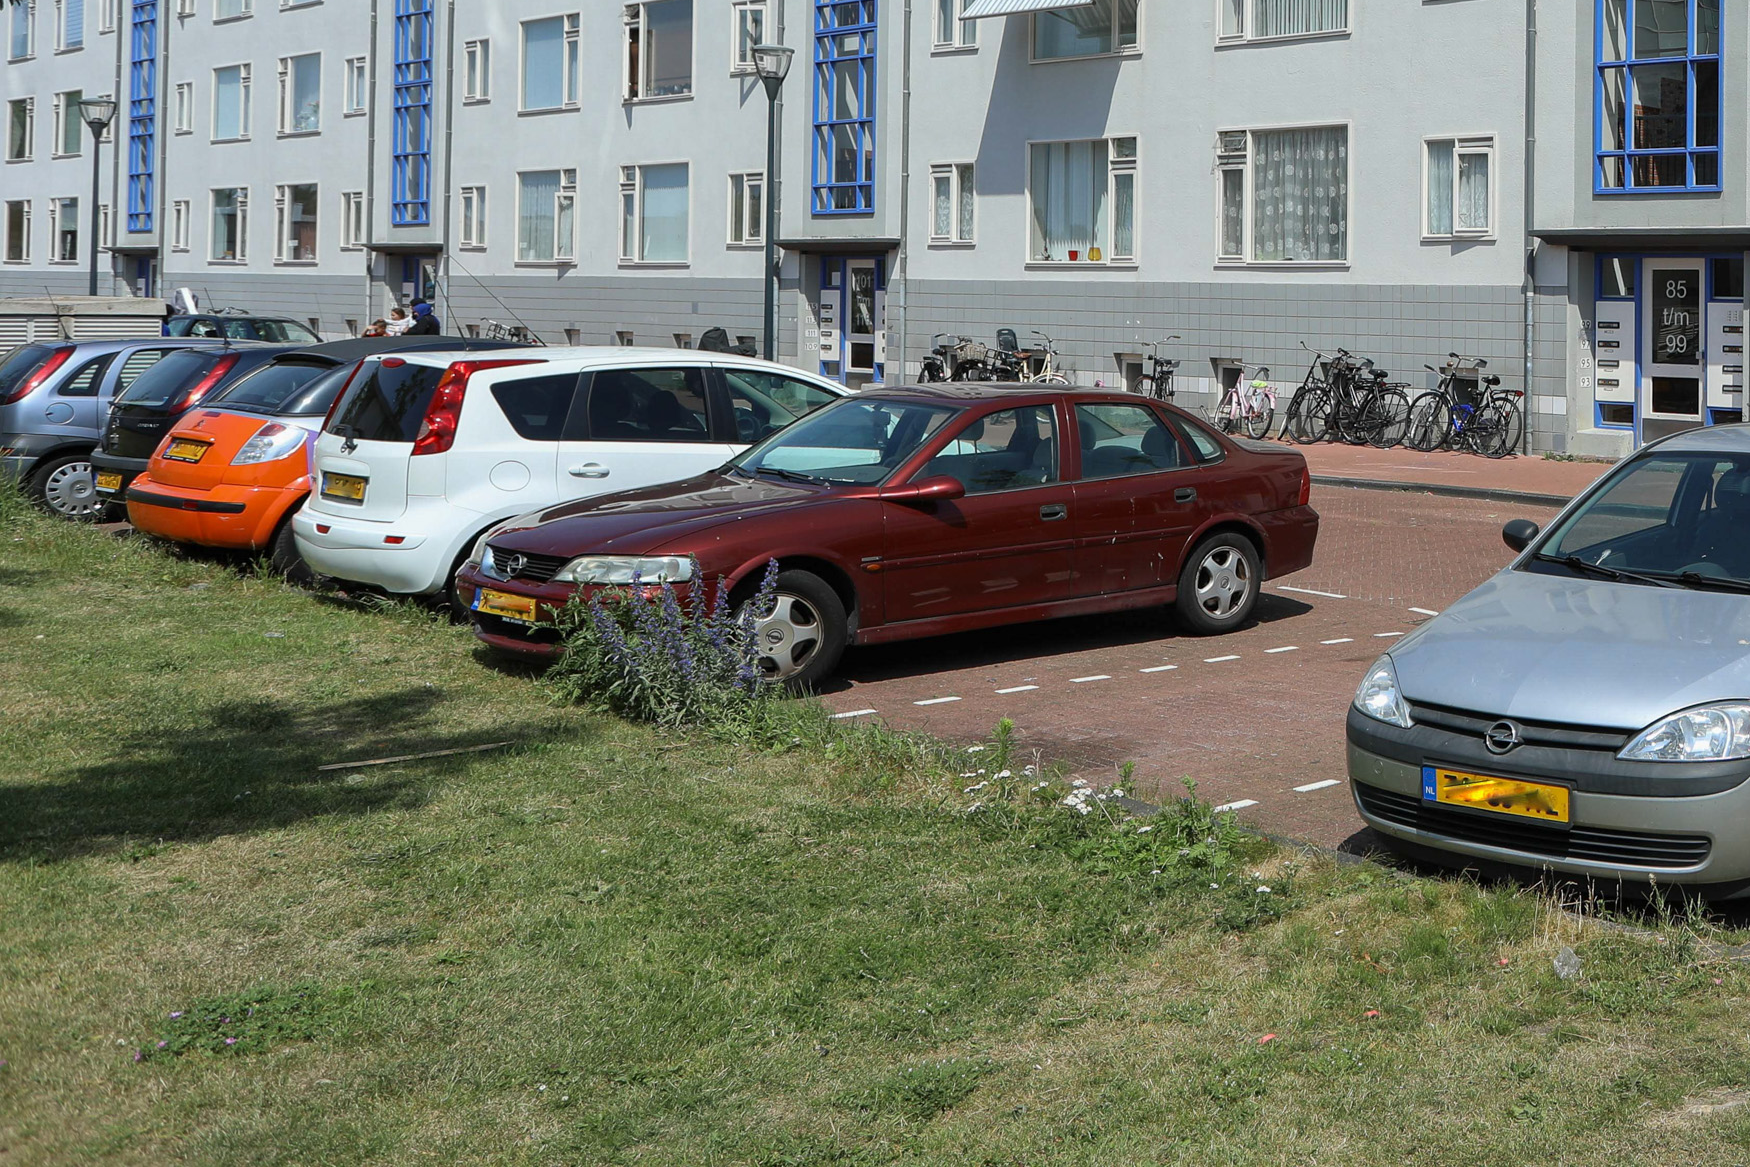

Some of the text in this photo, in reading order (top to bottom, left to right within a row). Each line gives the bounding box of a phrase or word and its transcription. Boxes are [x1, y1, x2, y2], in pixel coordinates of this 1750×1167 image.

[857, 275, 871, 288] 101
[1665, 280, 1687, 299] 85
[1663, 307, 1690, 326] t/m
[1581, 320, 1591, 328] 99
[1581, 339, 1591, 349] 97
[1665, 334, 1687, 353] 99
[1581, 358, 1591, 368] 95
[1581, 377, 1591, 387] 93
[1425, 786, 1435, 795] NL
